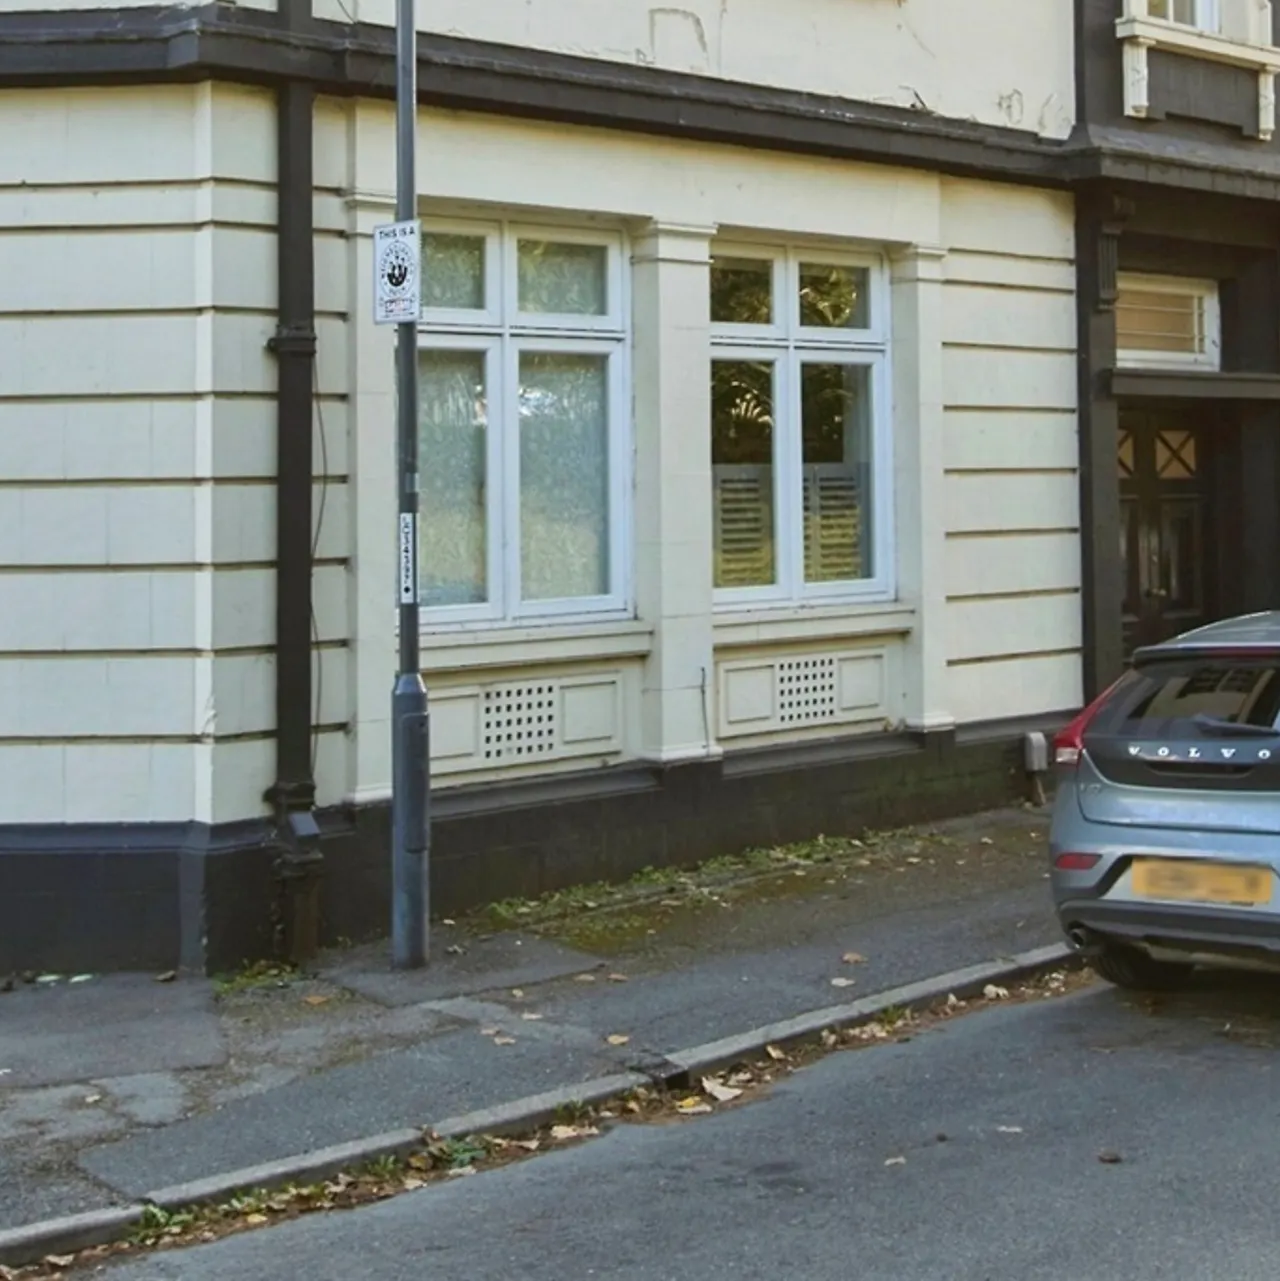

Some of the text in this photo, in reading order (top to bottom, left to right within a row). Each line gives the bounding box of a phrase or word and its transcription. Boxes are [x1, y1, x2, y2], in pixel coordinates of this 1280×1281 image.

[378, 226, 416, 241] THIS IS A
